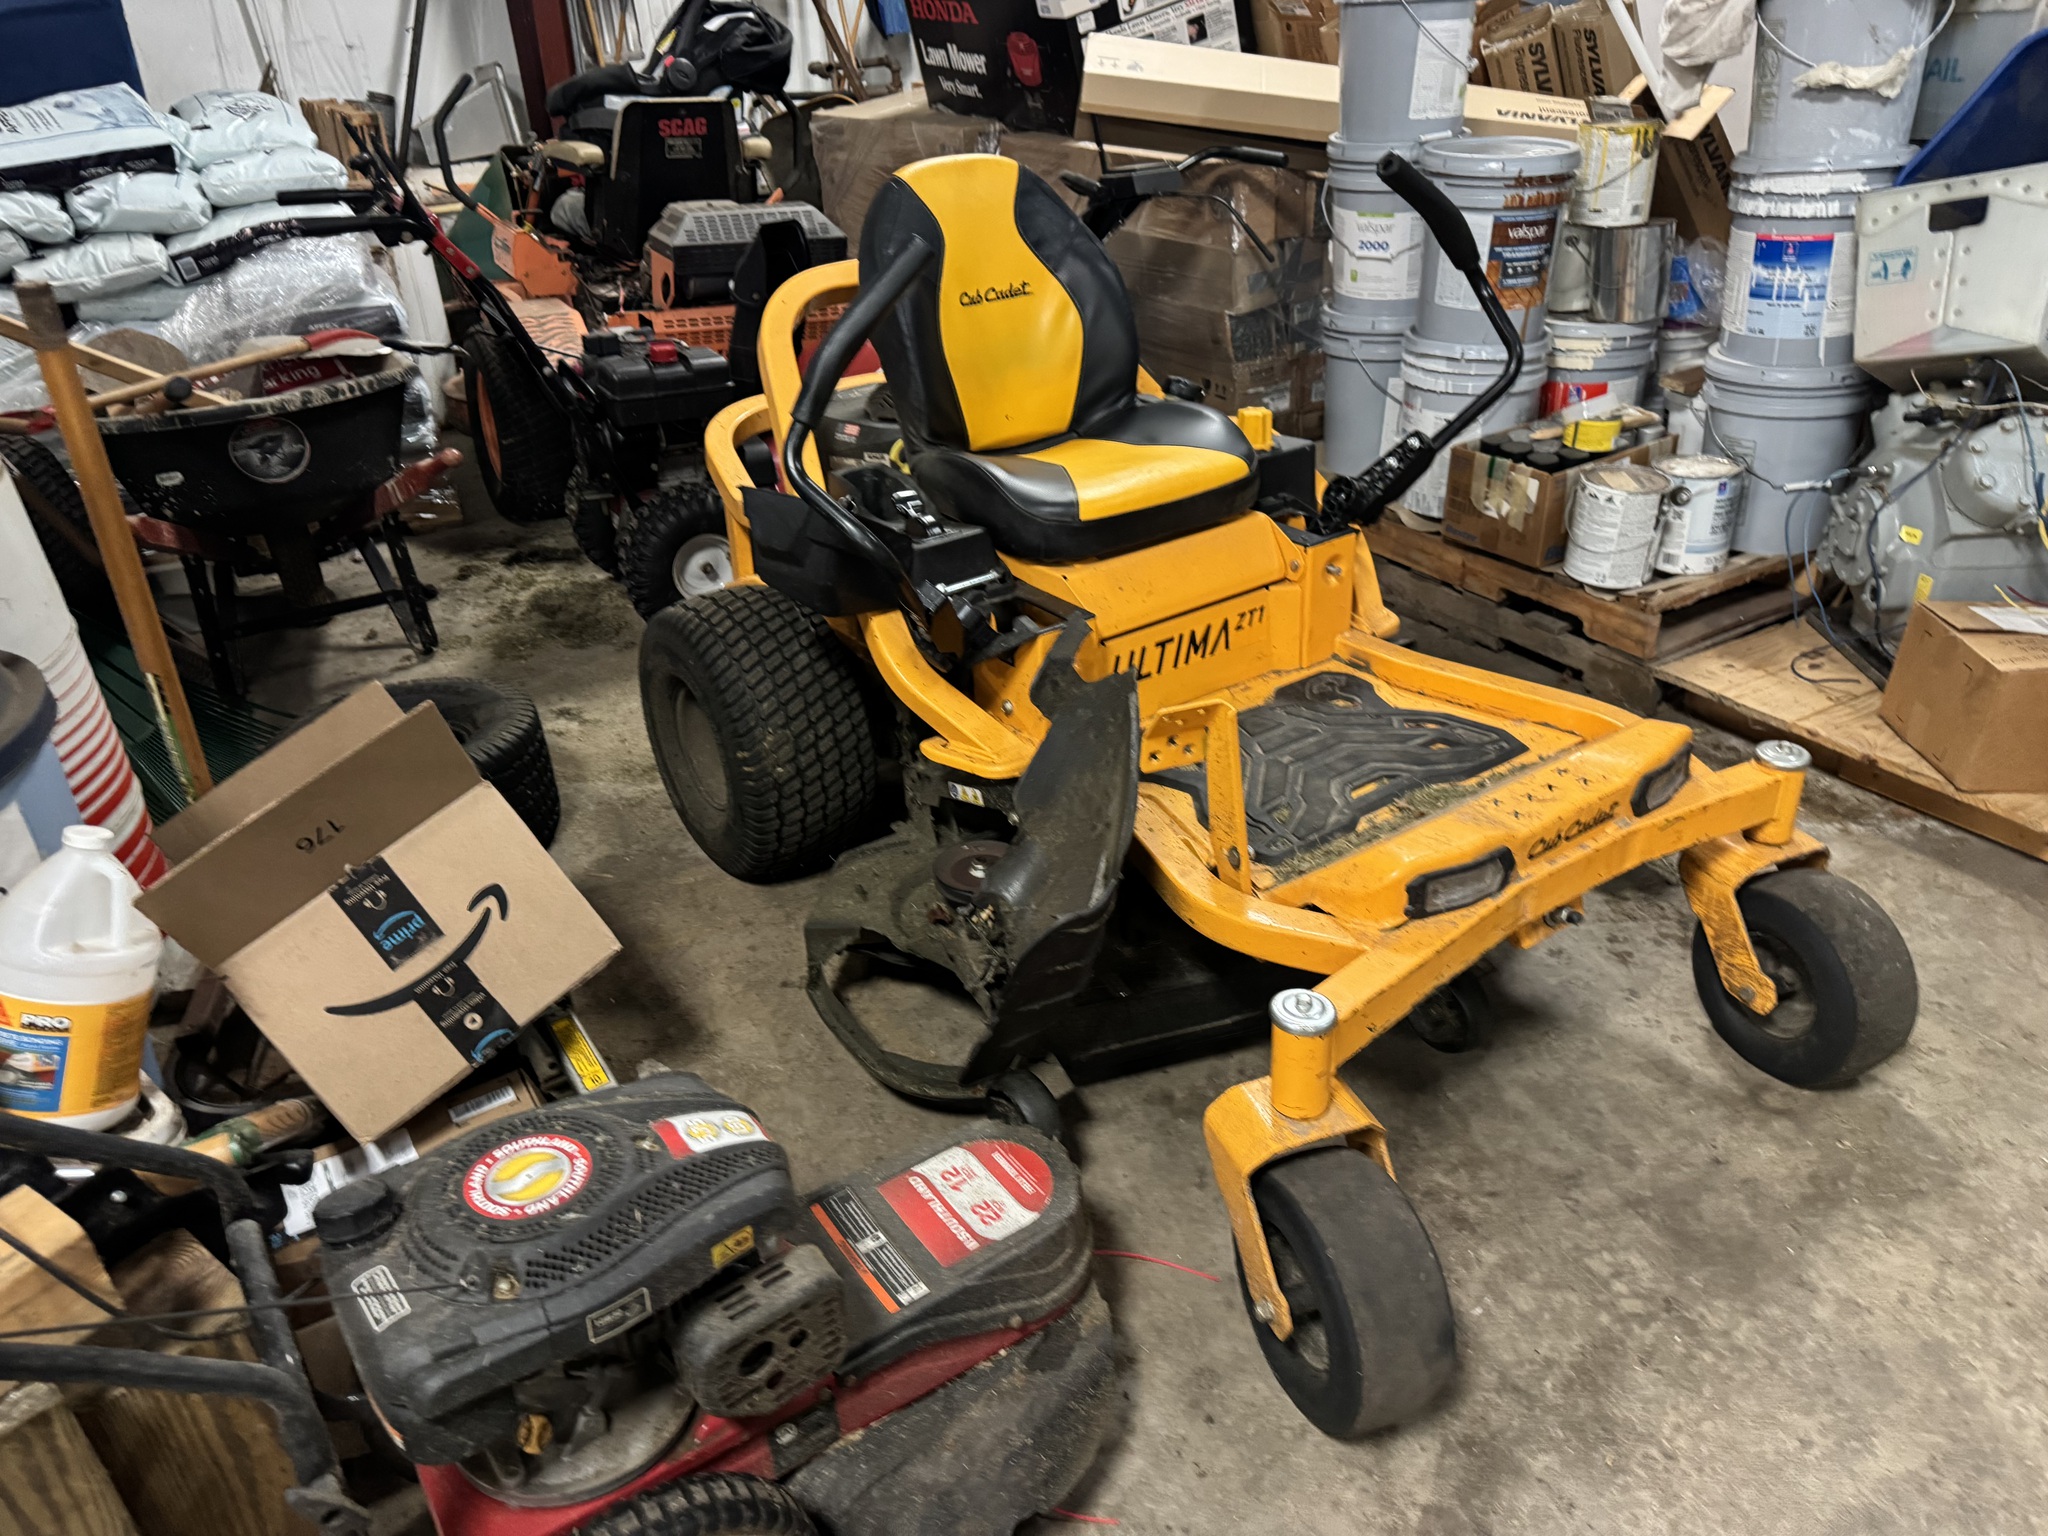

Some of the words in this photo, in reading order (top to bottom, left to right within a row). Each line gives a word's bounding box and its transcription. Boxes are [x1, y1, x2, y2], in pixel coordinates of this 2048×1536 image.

[910, 0, 979, 25] HONDA
[919, 38, 950, 69] Lawn
[946, 42, 987, 76] Mower
[938, 75, 957, 98] Very
[658, 116, 708, 138] SCAG
[1508, 221, 1549, 242] valspar
[1358, 239, 1390, 252] 2000
[959, 289, 983, 307] Cub
[984, 280, 1035, 303] Cadet
[1114, 617, 1230, 681] ULTIMA
[1234, 605, 1265, 631] ZT1
[296, 819, 345, 853] 176
[1528, 828, 1562, 860] Cub
[1564, 801, 1619, 842] Cadet
[380, 912, 426, 952] prime
[20, 1011, 72, 1033] PRO
[491, 1136, 580, 1160] SOUTHLAND
[939, 1164, 968, 1193] 12
[970, 1199, 1002, 1227] 22
